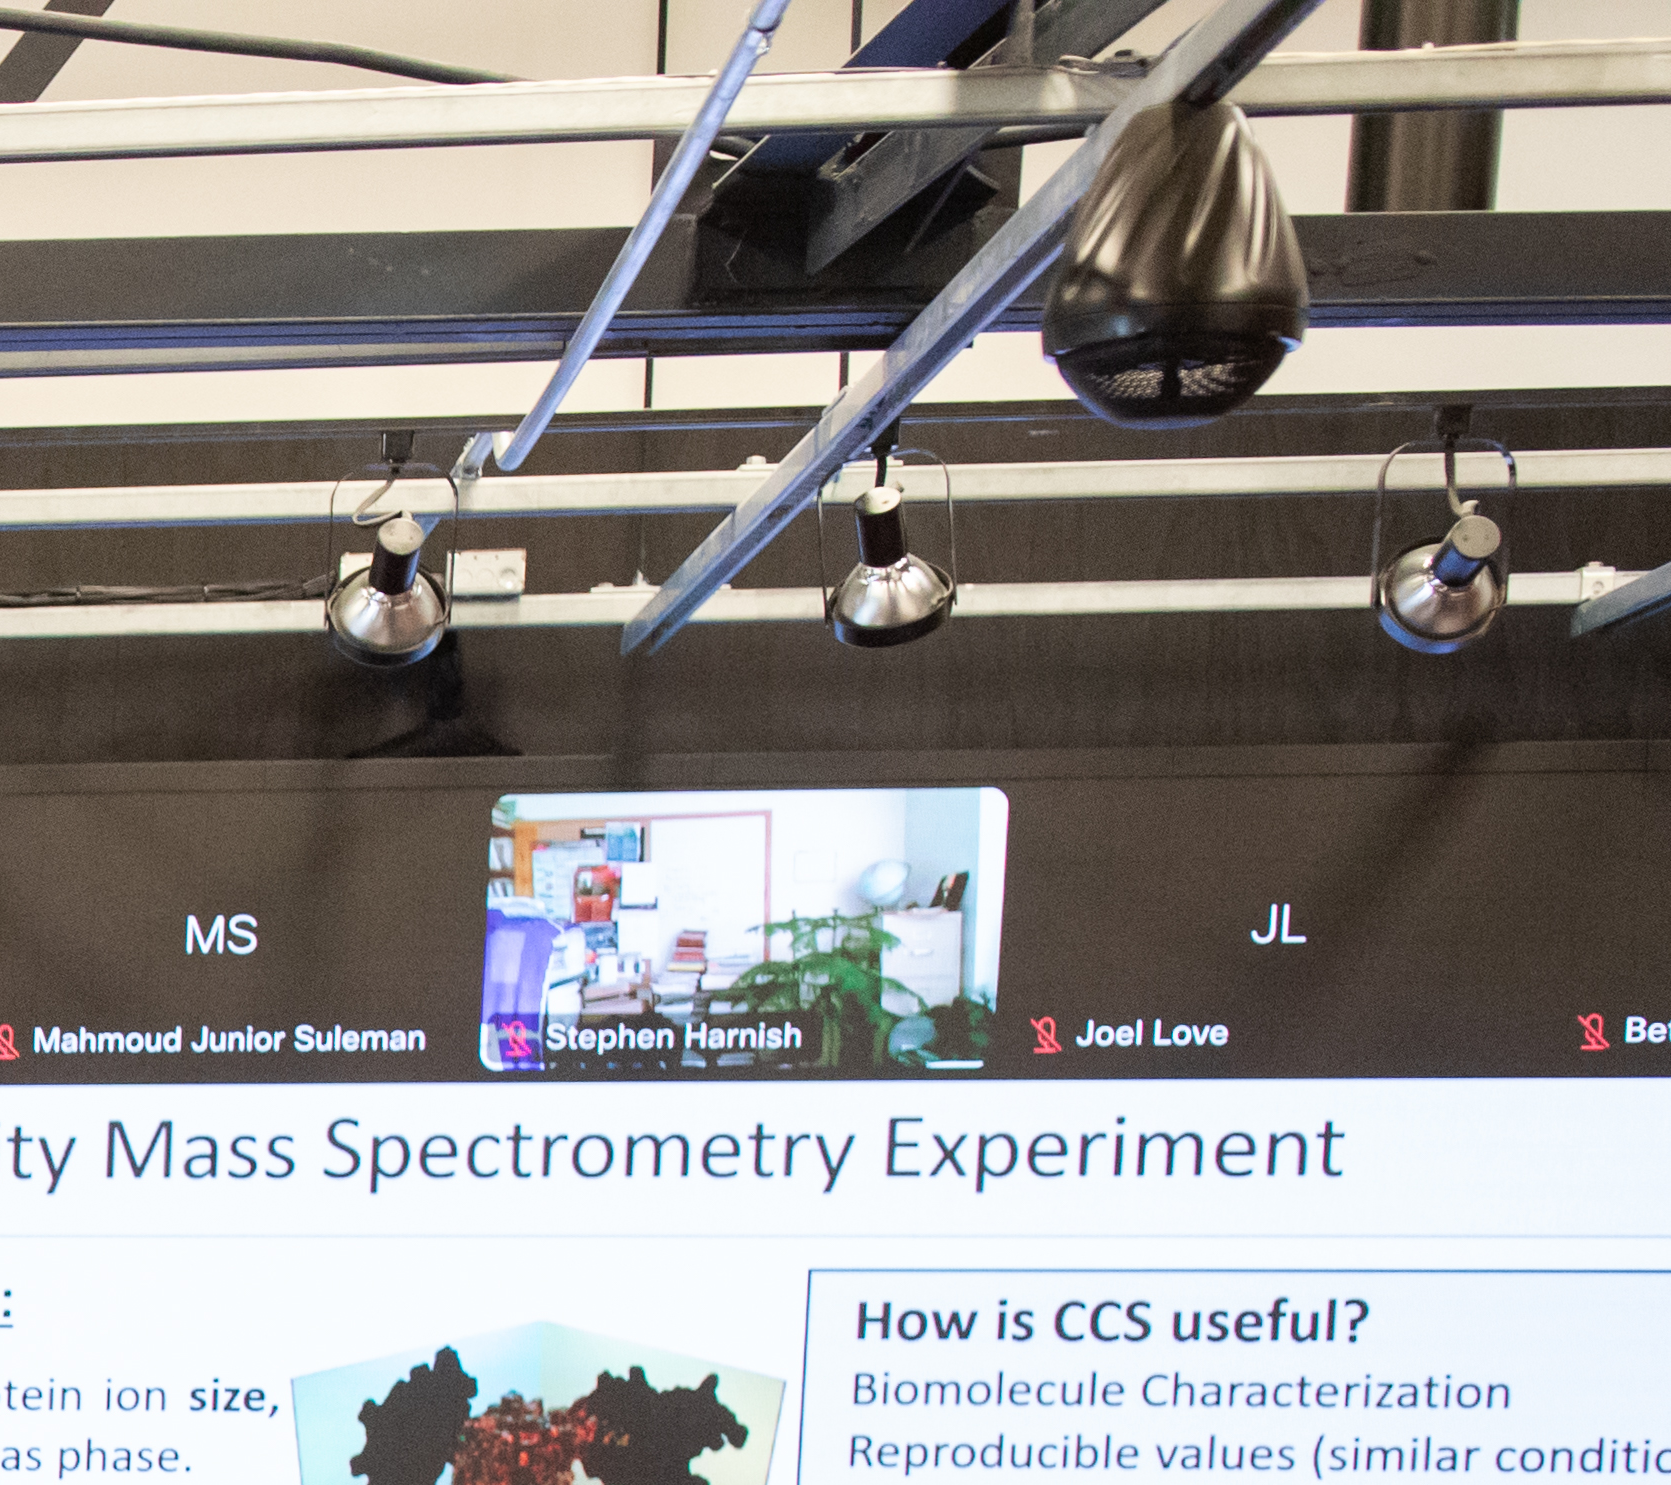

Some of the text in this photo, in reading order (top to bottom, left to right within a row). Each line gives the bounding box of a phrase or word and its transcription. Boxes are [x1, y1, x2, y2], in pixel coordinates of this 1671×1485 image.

[185, 914, 258, 955] MS
[1250, 904, 1307, 944] JL
[33, 1024, 427, 1054] Mahmoud Junior Suleman
[545, 1021, 802, 1055] Stephen Harnish
[1075, 1018, 1230, 1047] Joel Love
[1624, 1016, 1671, 1043] Be
[105, 1120, 296, 1179] Mass
[322, 1118, 856, 1195] Spectrometry
[885, 1116, 1346, 1193] Experiment
[856, 1297, 1371, 1343] How is CCS useful?
[105, 1386, 167, 1412] ion
[188, 1377, 280, 1418] size,
[852, 1370, 1511, 1409] Biomolecule Characterization
[58, 1438, 191, 1480] phase.
[848, 1432, 1140, 1477] Reproducible
[1155, 1434, 1296, 1471] values
[1312, 1434, 1481, 1480] (similar
